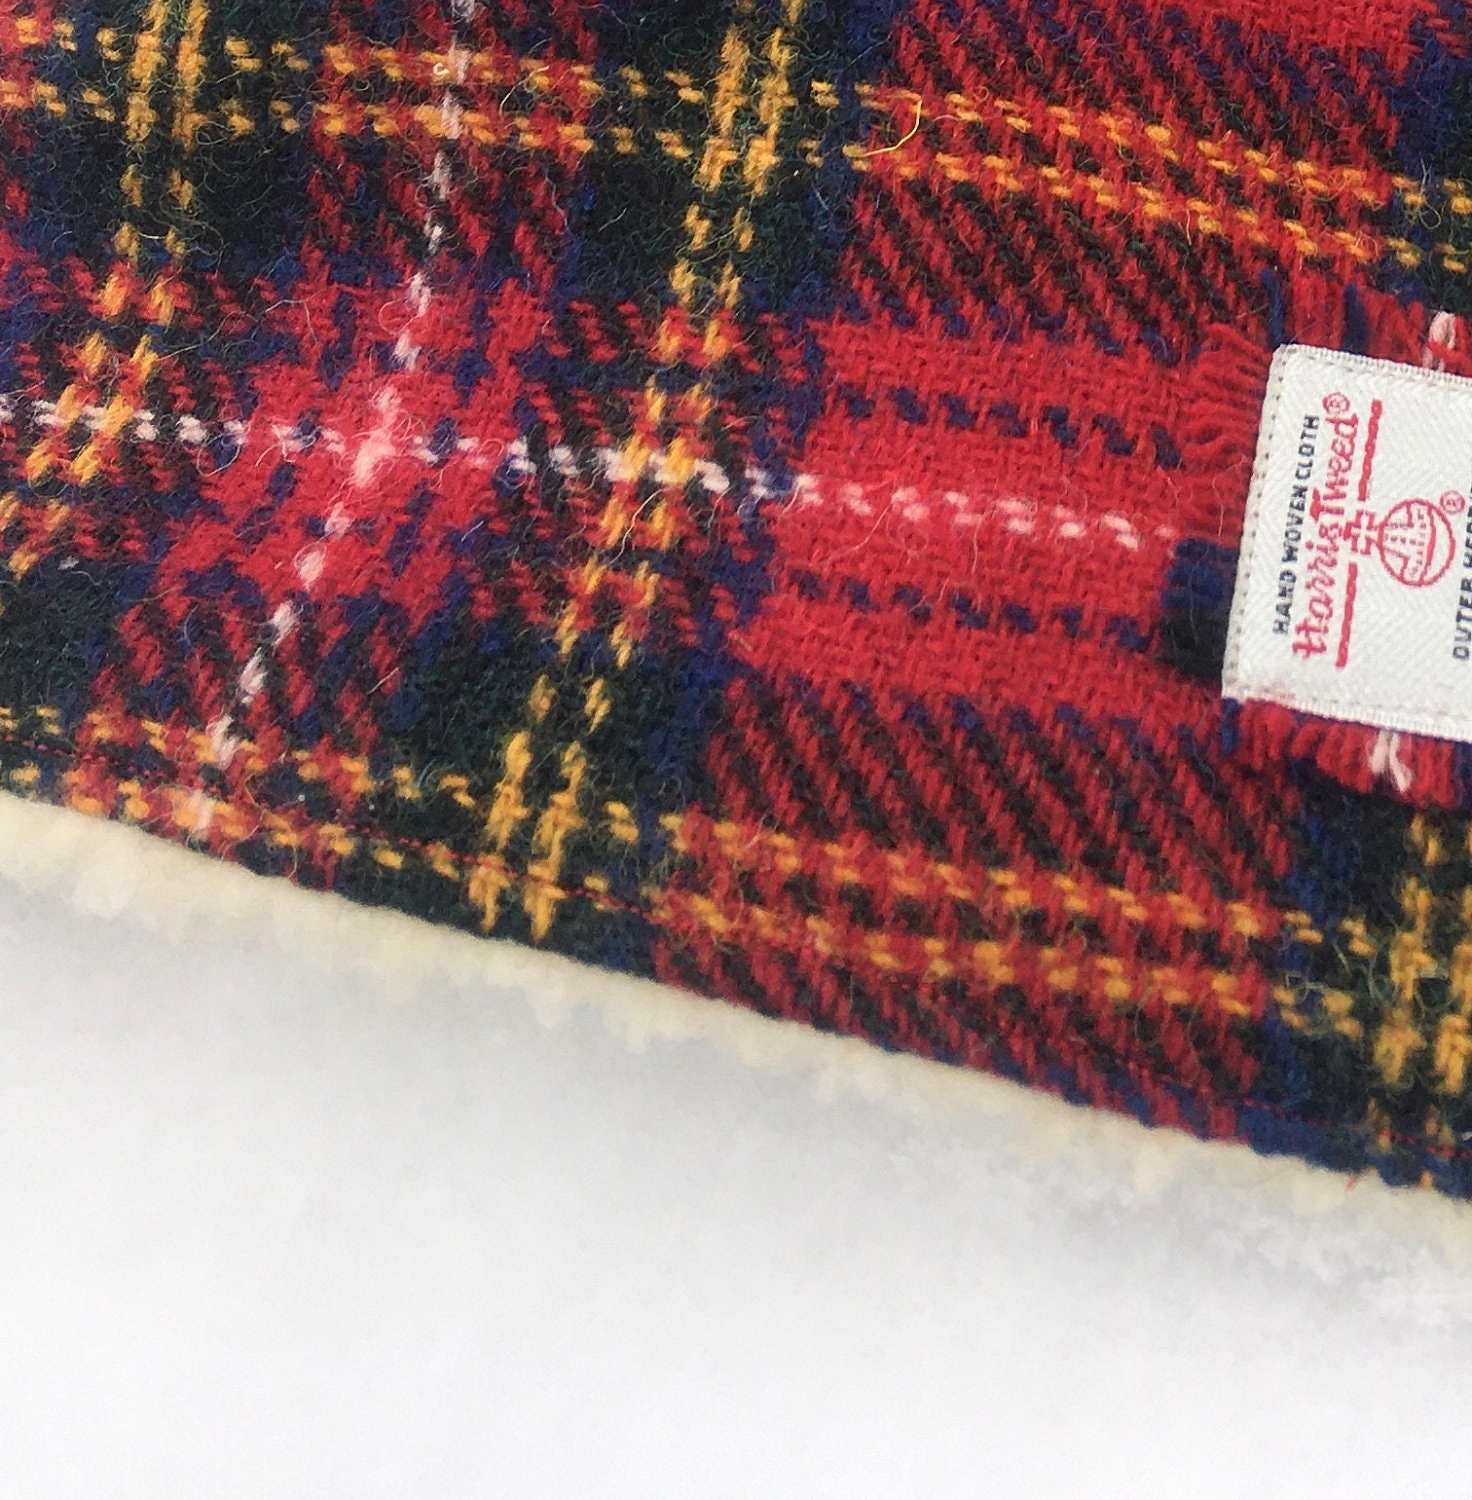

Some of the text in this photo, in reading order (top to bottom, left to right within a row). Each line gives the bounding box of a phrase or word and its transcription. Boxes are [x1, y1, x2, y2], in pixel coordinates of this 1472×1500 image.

[1272, 414, 1320, 635] HAND WOVEN CLOTH
[1292, 521, 1343, 660] Harris
